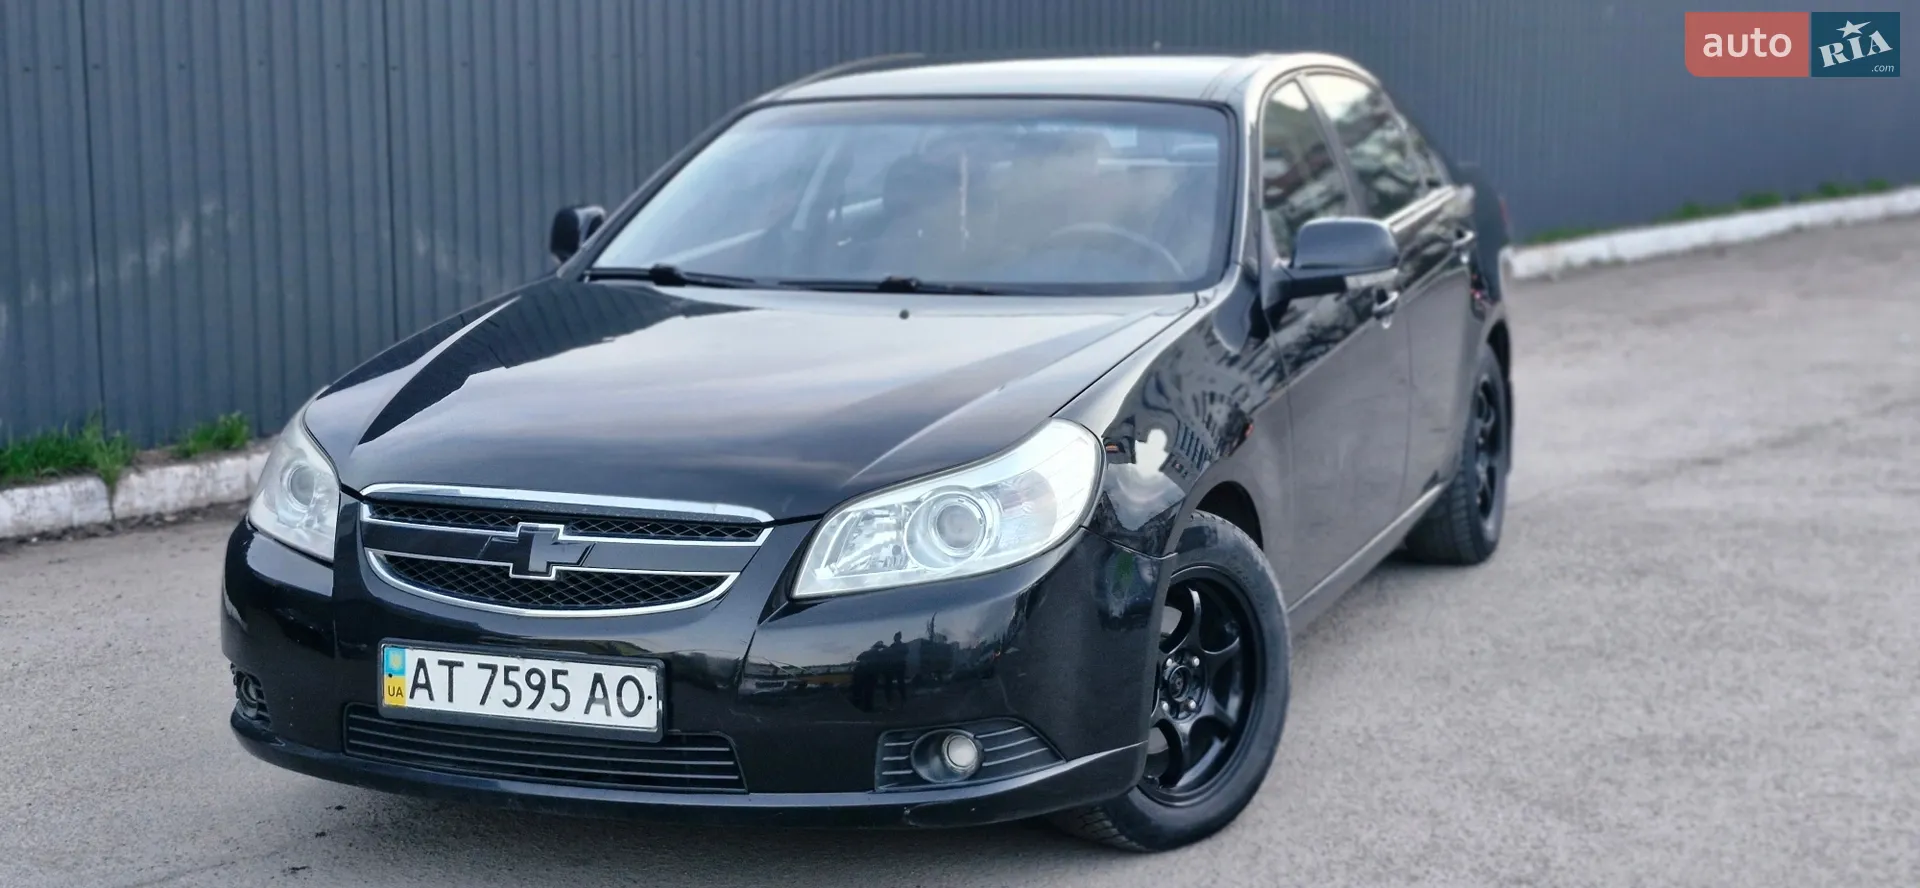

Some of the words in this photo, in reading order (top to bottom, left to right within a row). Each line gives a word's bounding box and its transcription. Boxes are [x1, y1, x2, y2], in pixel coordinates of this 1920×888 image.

[387, 686, 404, 698] UA
[409, 658, 464, 703] AT
[477, 663, 571, 712] 7595
[583, 672, 645, 718] AO
